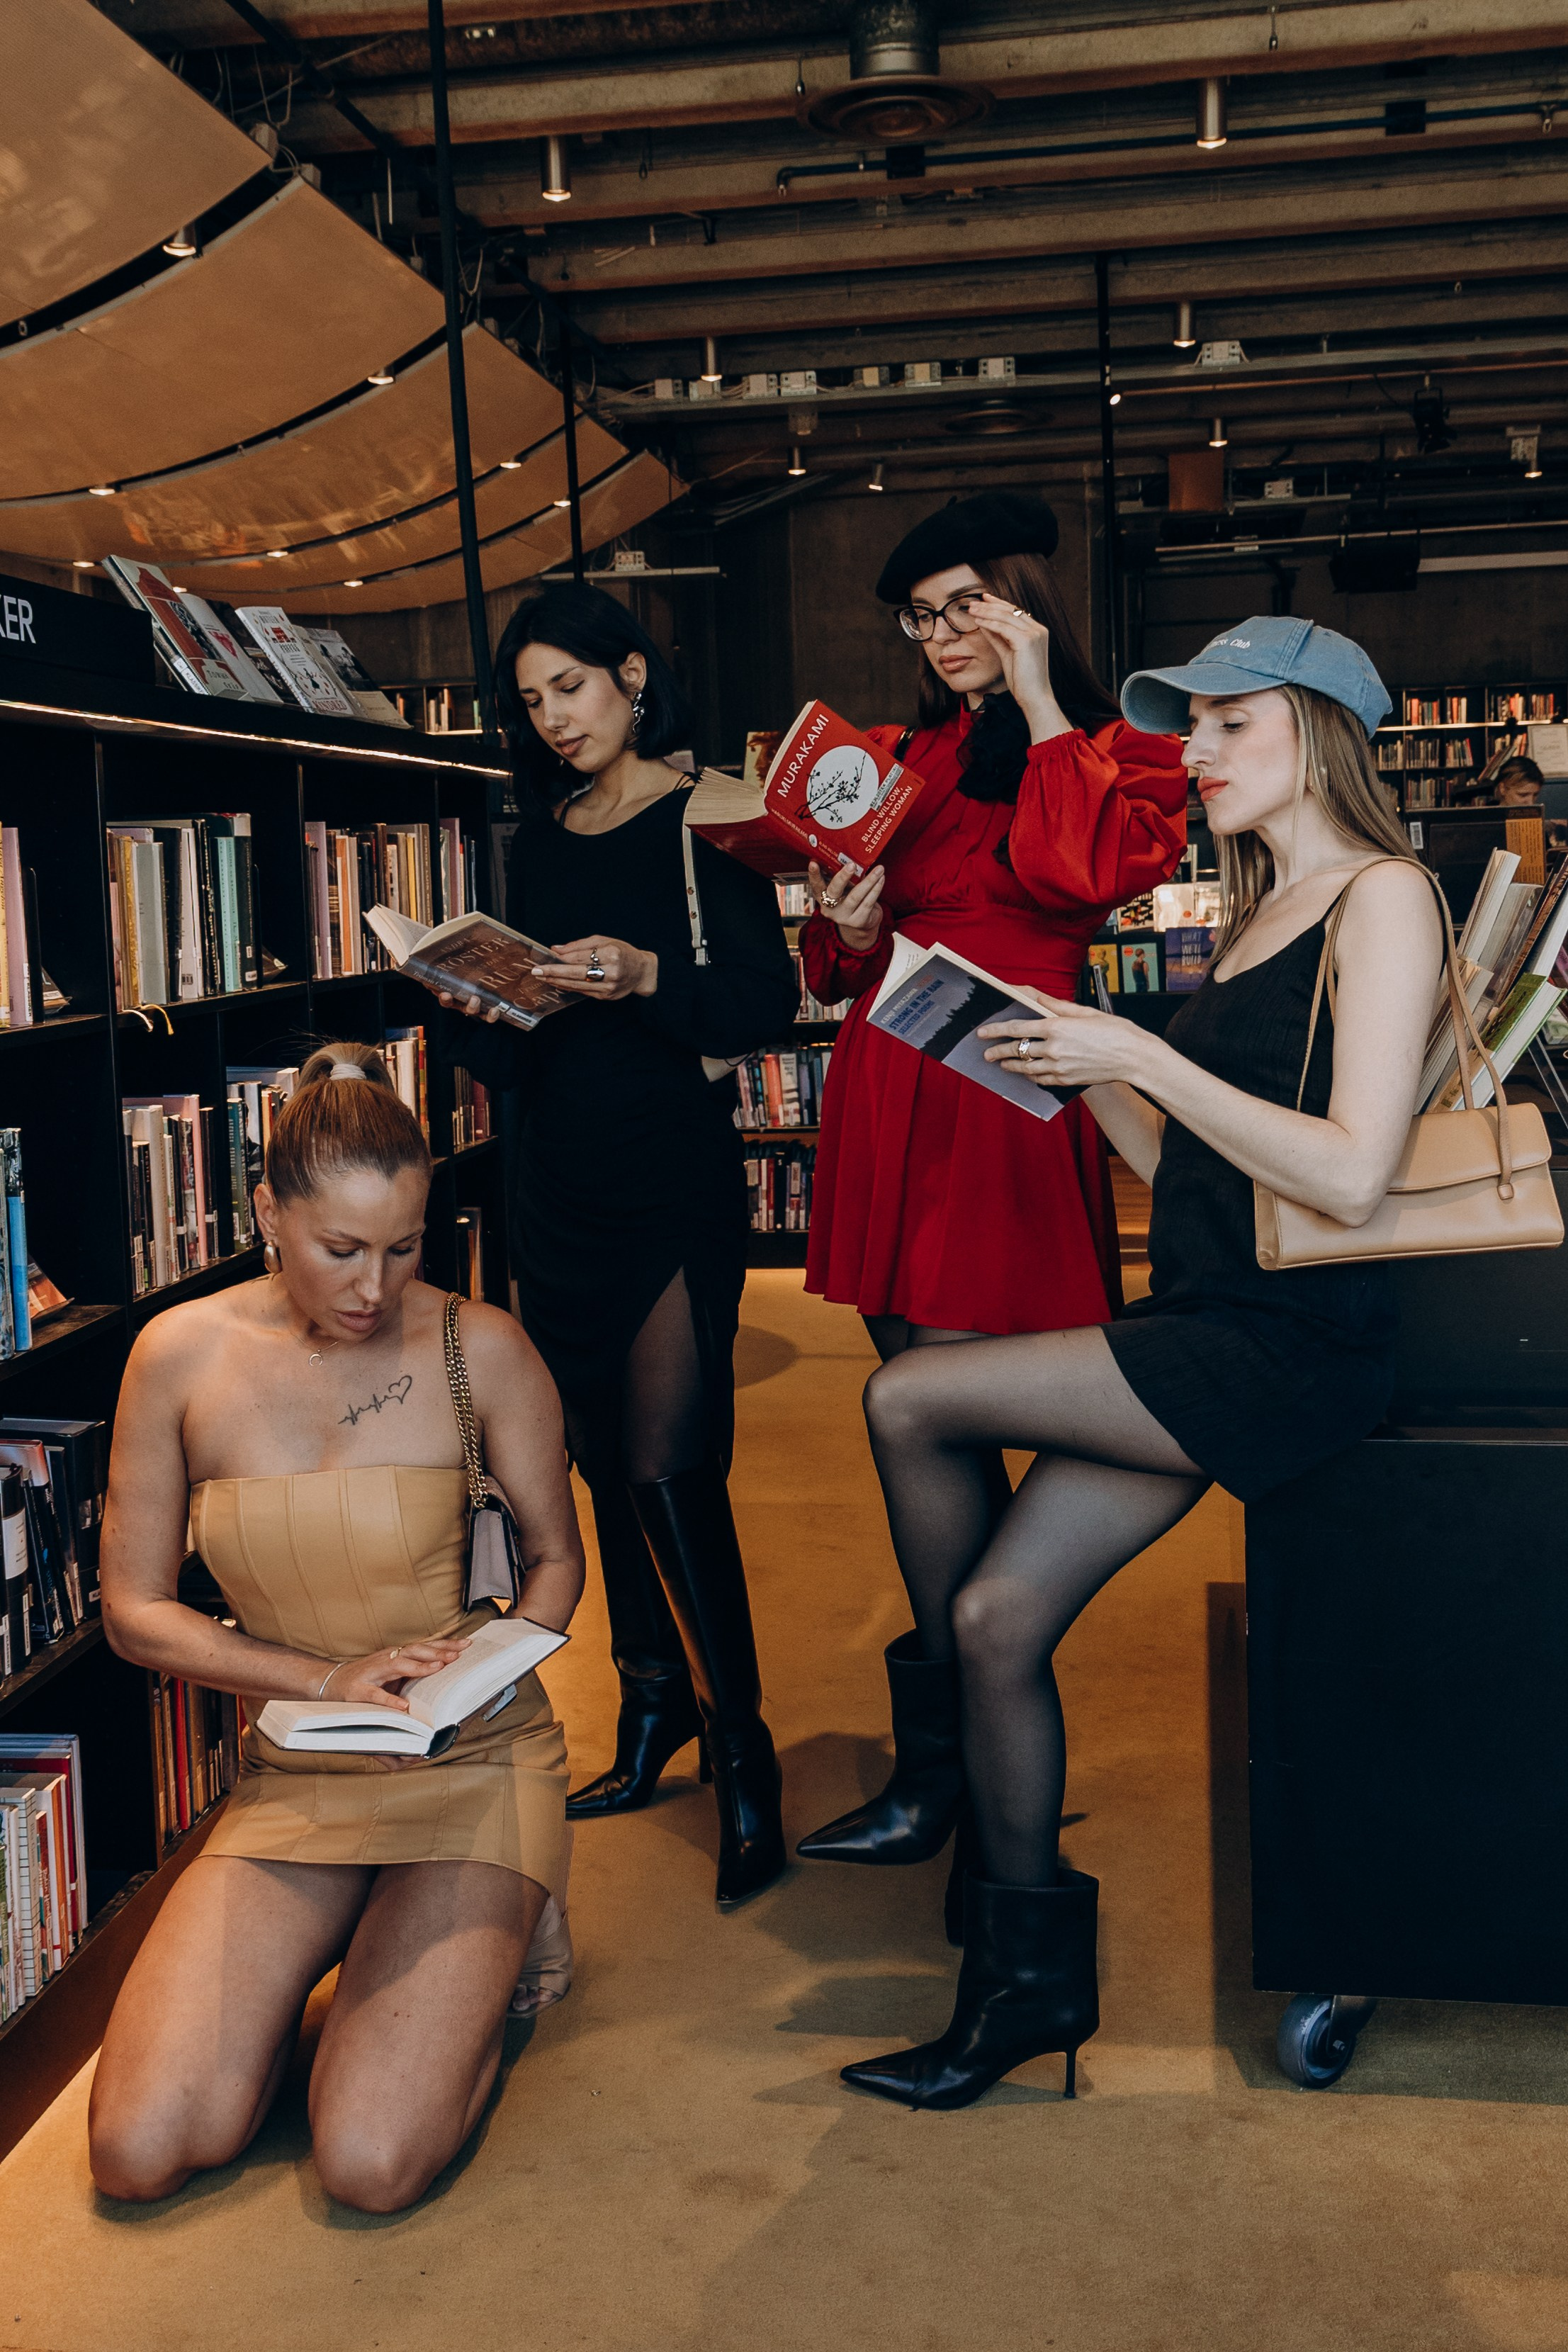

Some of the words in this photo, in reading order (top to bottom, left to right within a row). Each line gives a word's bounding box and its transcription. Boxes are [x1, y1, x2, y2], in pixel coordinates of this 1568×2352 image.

[0, 594, 36, 643] ER
[1230, 638, 1251, 648] Club
[777, 714, 829, 797] MURAKAMI
[861, 818, 879, 843] BLIND
[877, 786, 903, 818] WILLOW,
[864, 817, 892, 853] SLEEPING
[889, 785, 913, 818] WOMAN
[436, 938, 511, 973] RÖSTER
[1181, 931, 1202, 943] WHAT
[889, 1007, 913, 1030] STRONG
[909, 1000, 920, 1009] IN
[915, 990, 931, 1002] THE
[926, 979, 944, 993] RAIN
[898, 1013, 921, 1035] SELECTED
